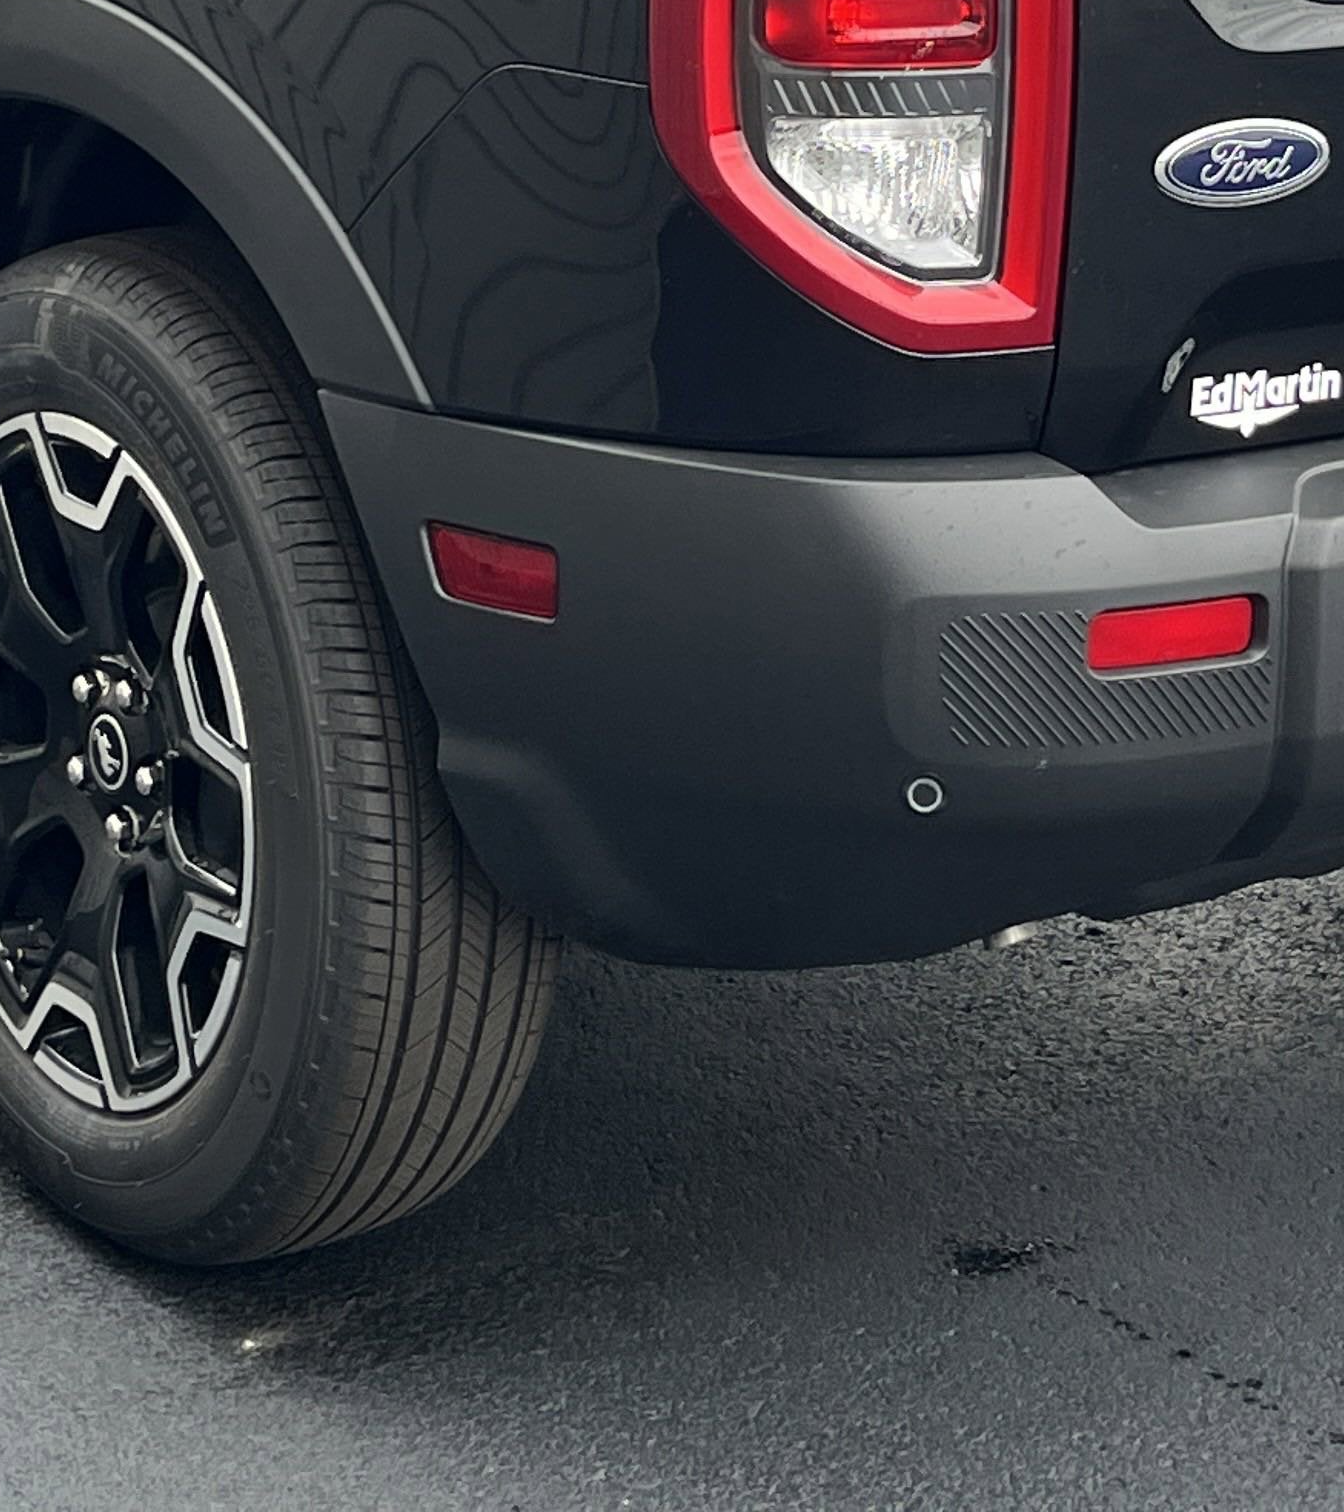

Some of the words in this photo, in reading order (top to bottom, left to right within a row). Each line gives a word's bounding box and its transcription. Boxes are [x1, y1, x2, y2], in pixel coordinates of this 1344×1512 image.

[1199, 138, 1296, 187] Ford
[1189, 362, 1343, 418] EdMartin
[96, 351, 228, 537] MICHELIN
